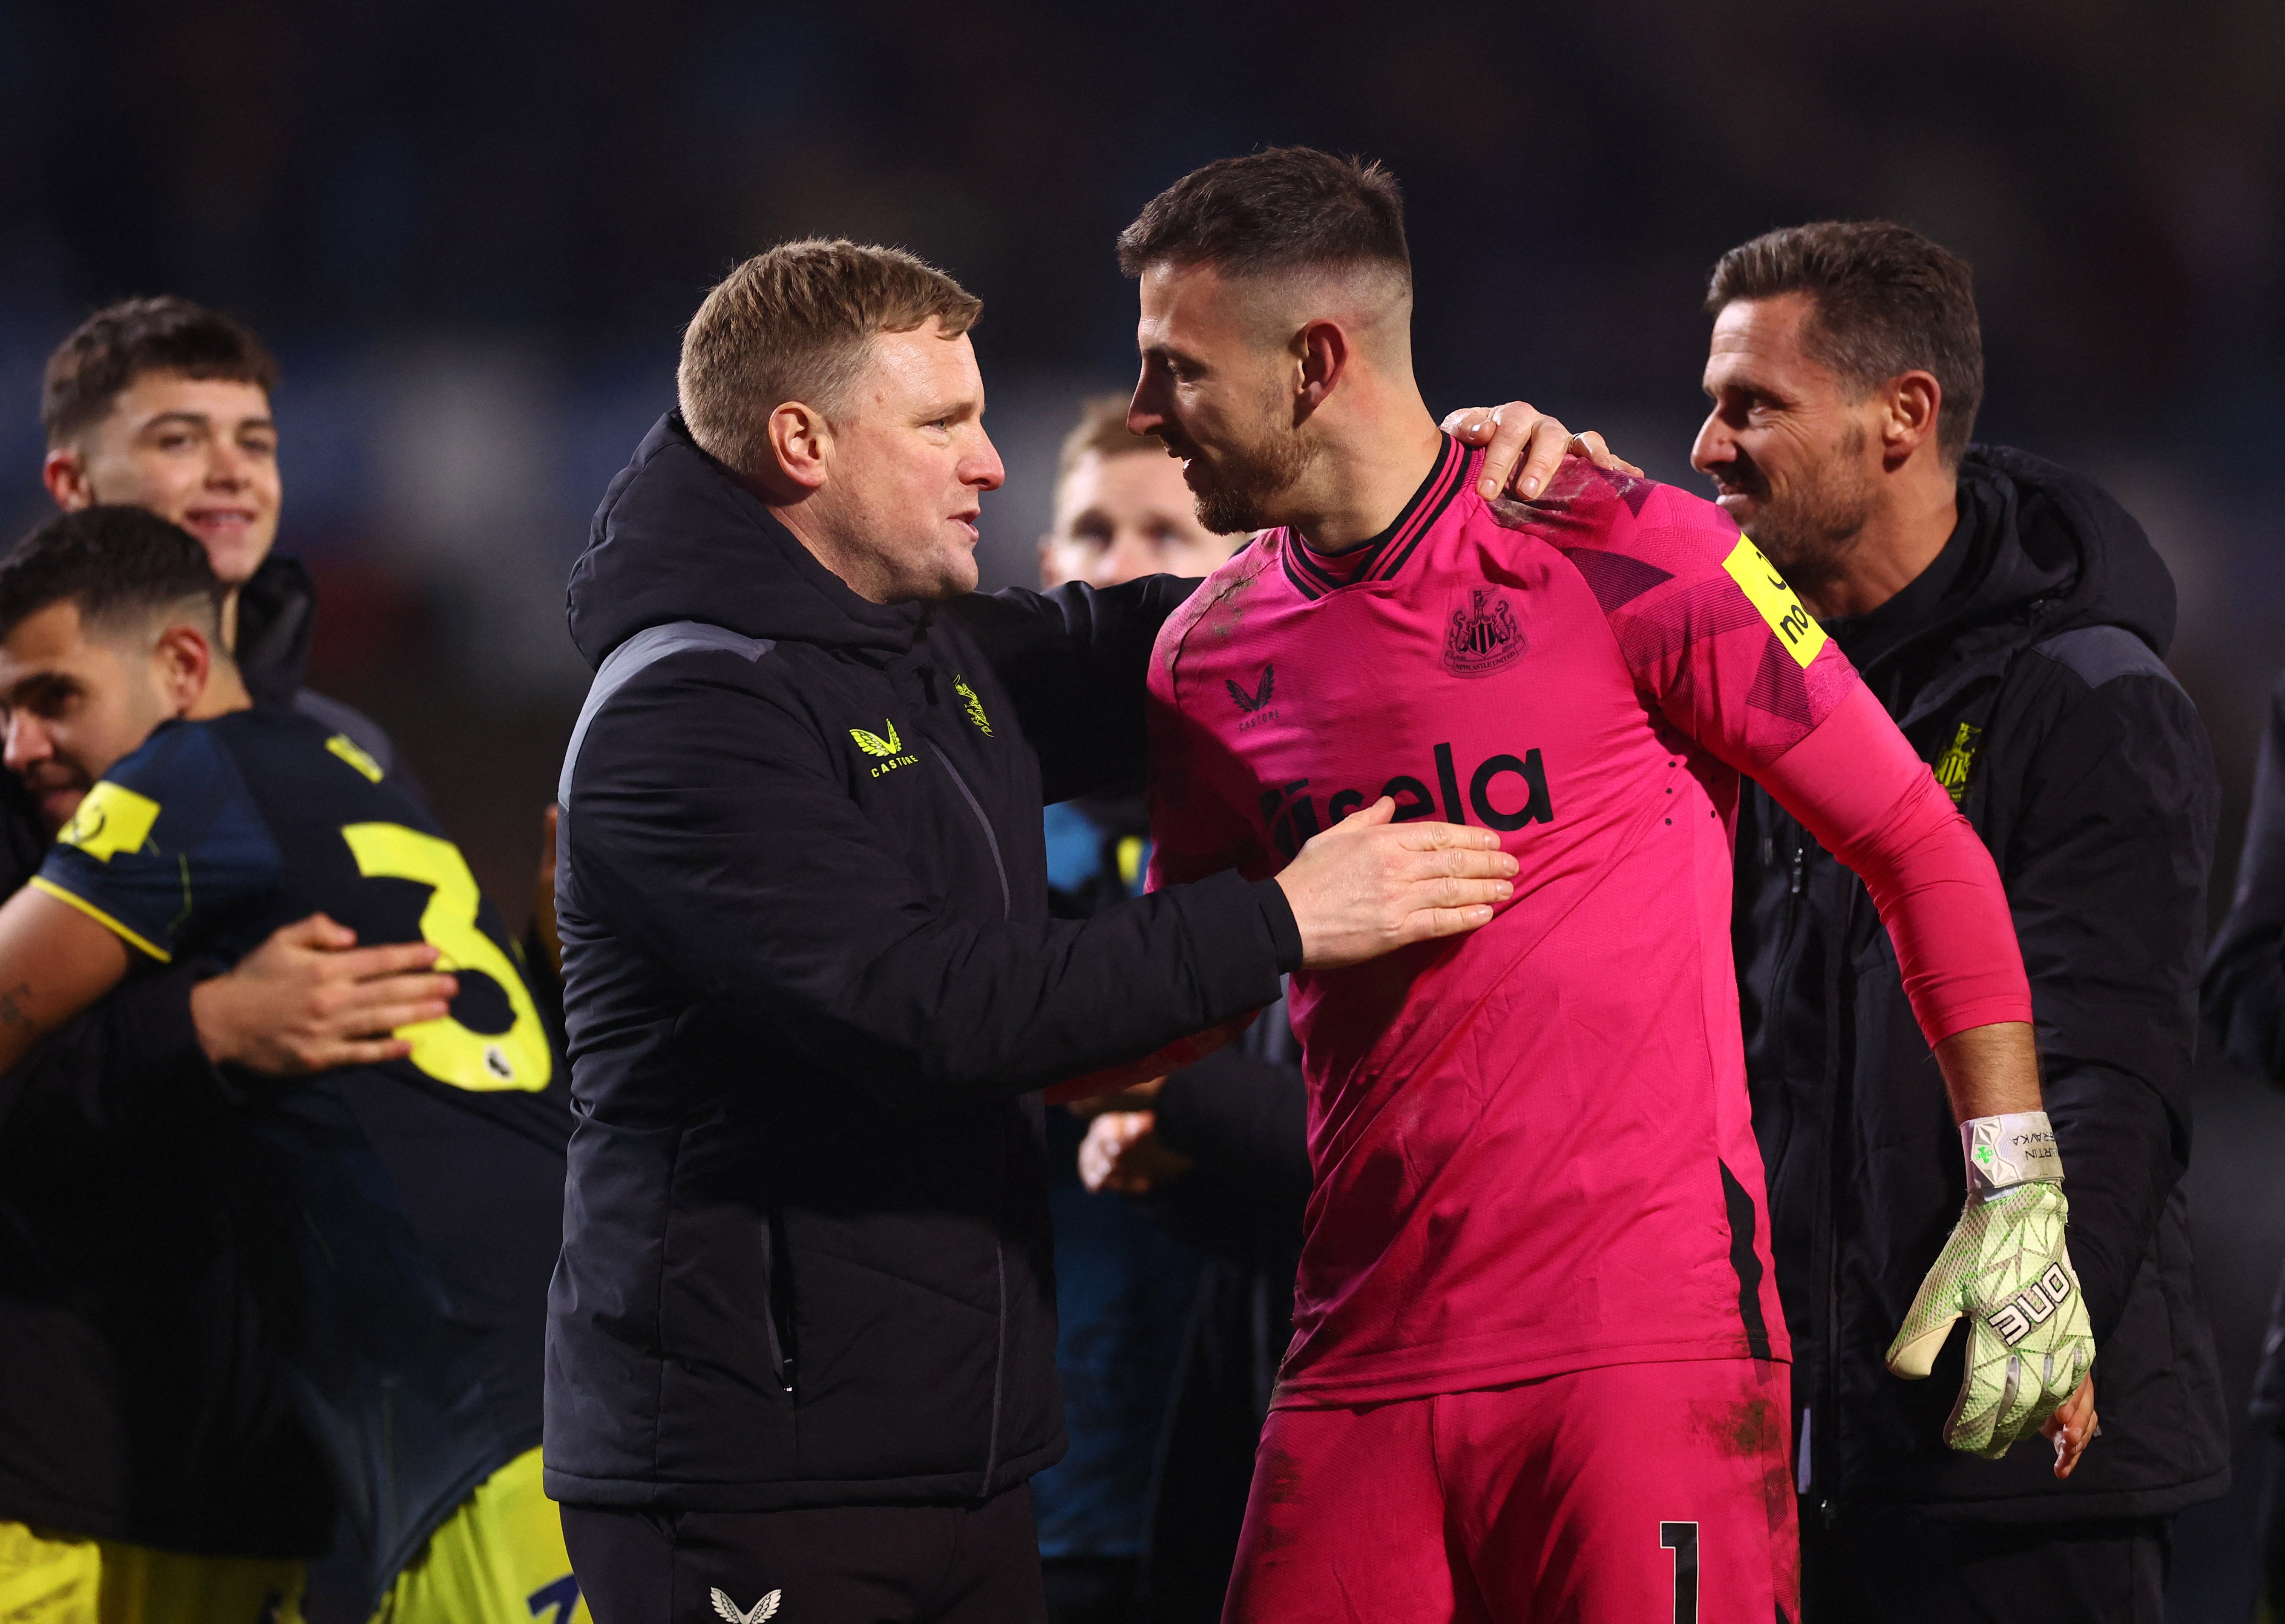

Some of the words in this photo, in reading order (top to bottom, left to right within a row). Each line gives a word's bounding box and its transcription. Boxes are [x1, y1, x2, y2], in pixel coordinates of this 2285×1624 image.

[1779, 603, 1810, 645] no
[1455, 662, 1491, 670] NEWCASTLE
[1492, 651, 1516, 666] UNITED
[1239, 709, 1280, 732] CASTORE
[1987, 1262, 2071, 1347] ONE
[1660, 1521, 1699, 1624] 1
